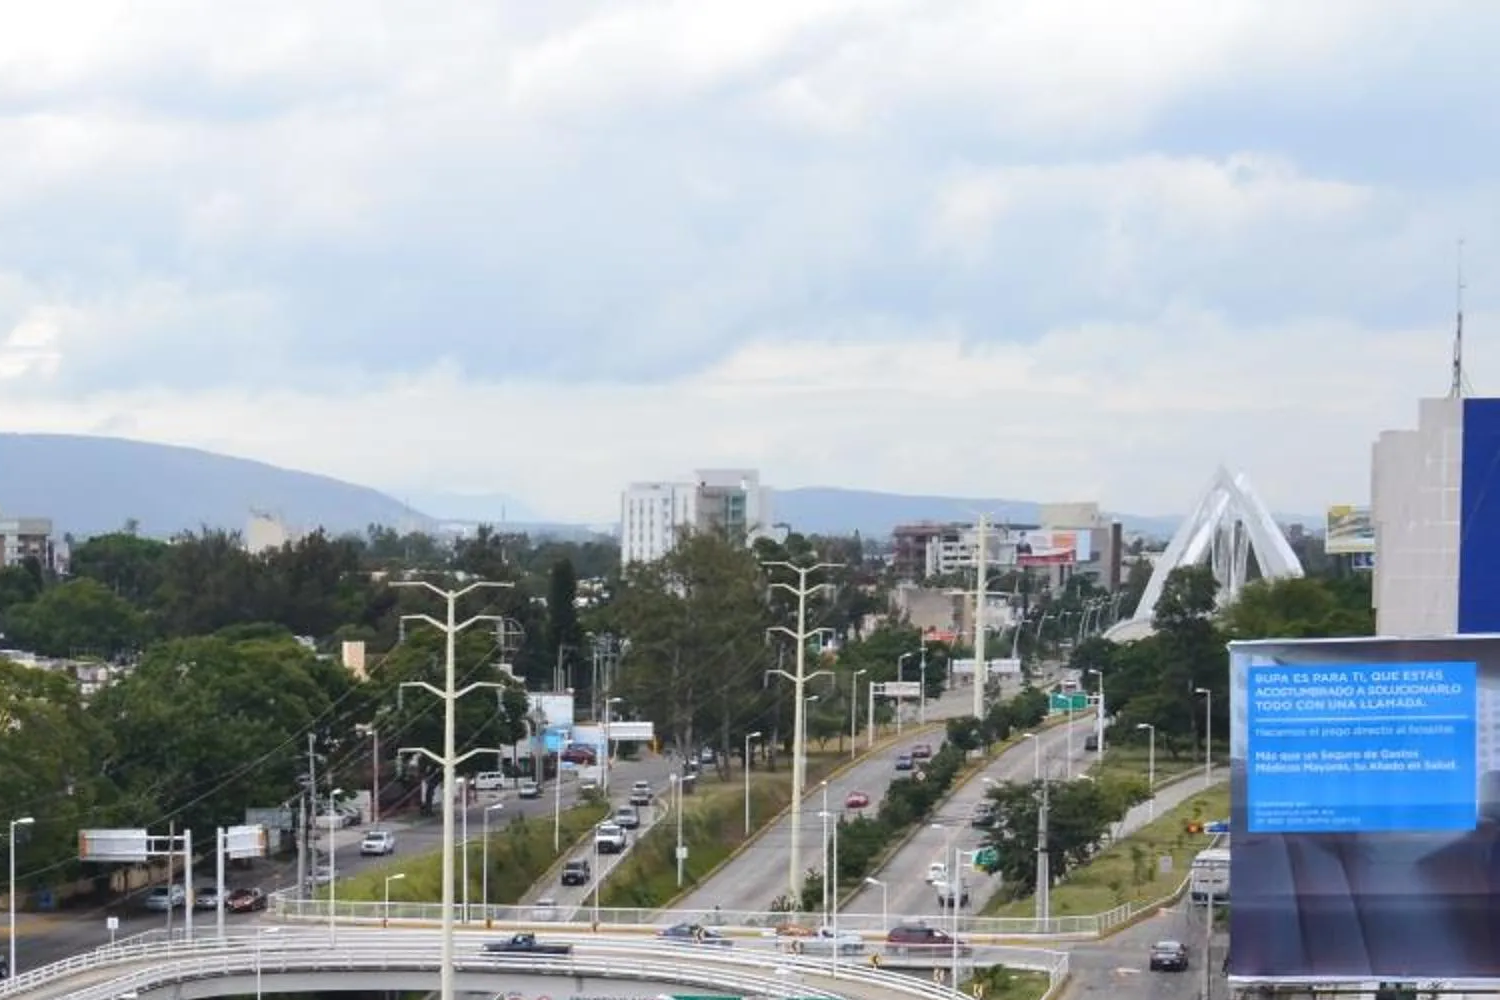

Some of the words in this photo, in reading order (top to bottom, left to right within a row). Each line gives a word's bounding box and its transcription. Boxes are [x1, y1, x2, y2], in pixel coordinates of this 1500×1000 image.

[1293, 672, 1309, 683] ES
[1313, 671, 1348, 682] PARA
[1372, 670, 1399, 681] QUE
[1356, 686, 1366, 696] A
[1255, 700, 1292, 711] TODO
[1296, 699, 1324, 711] CON
[1328, 699, 1355, 710] UNA
